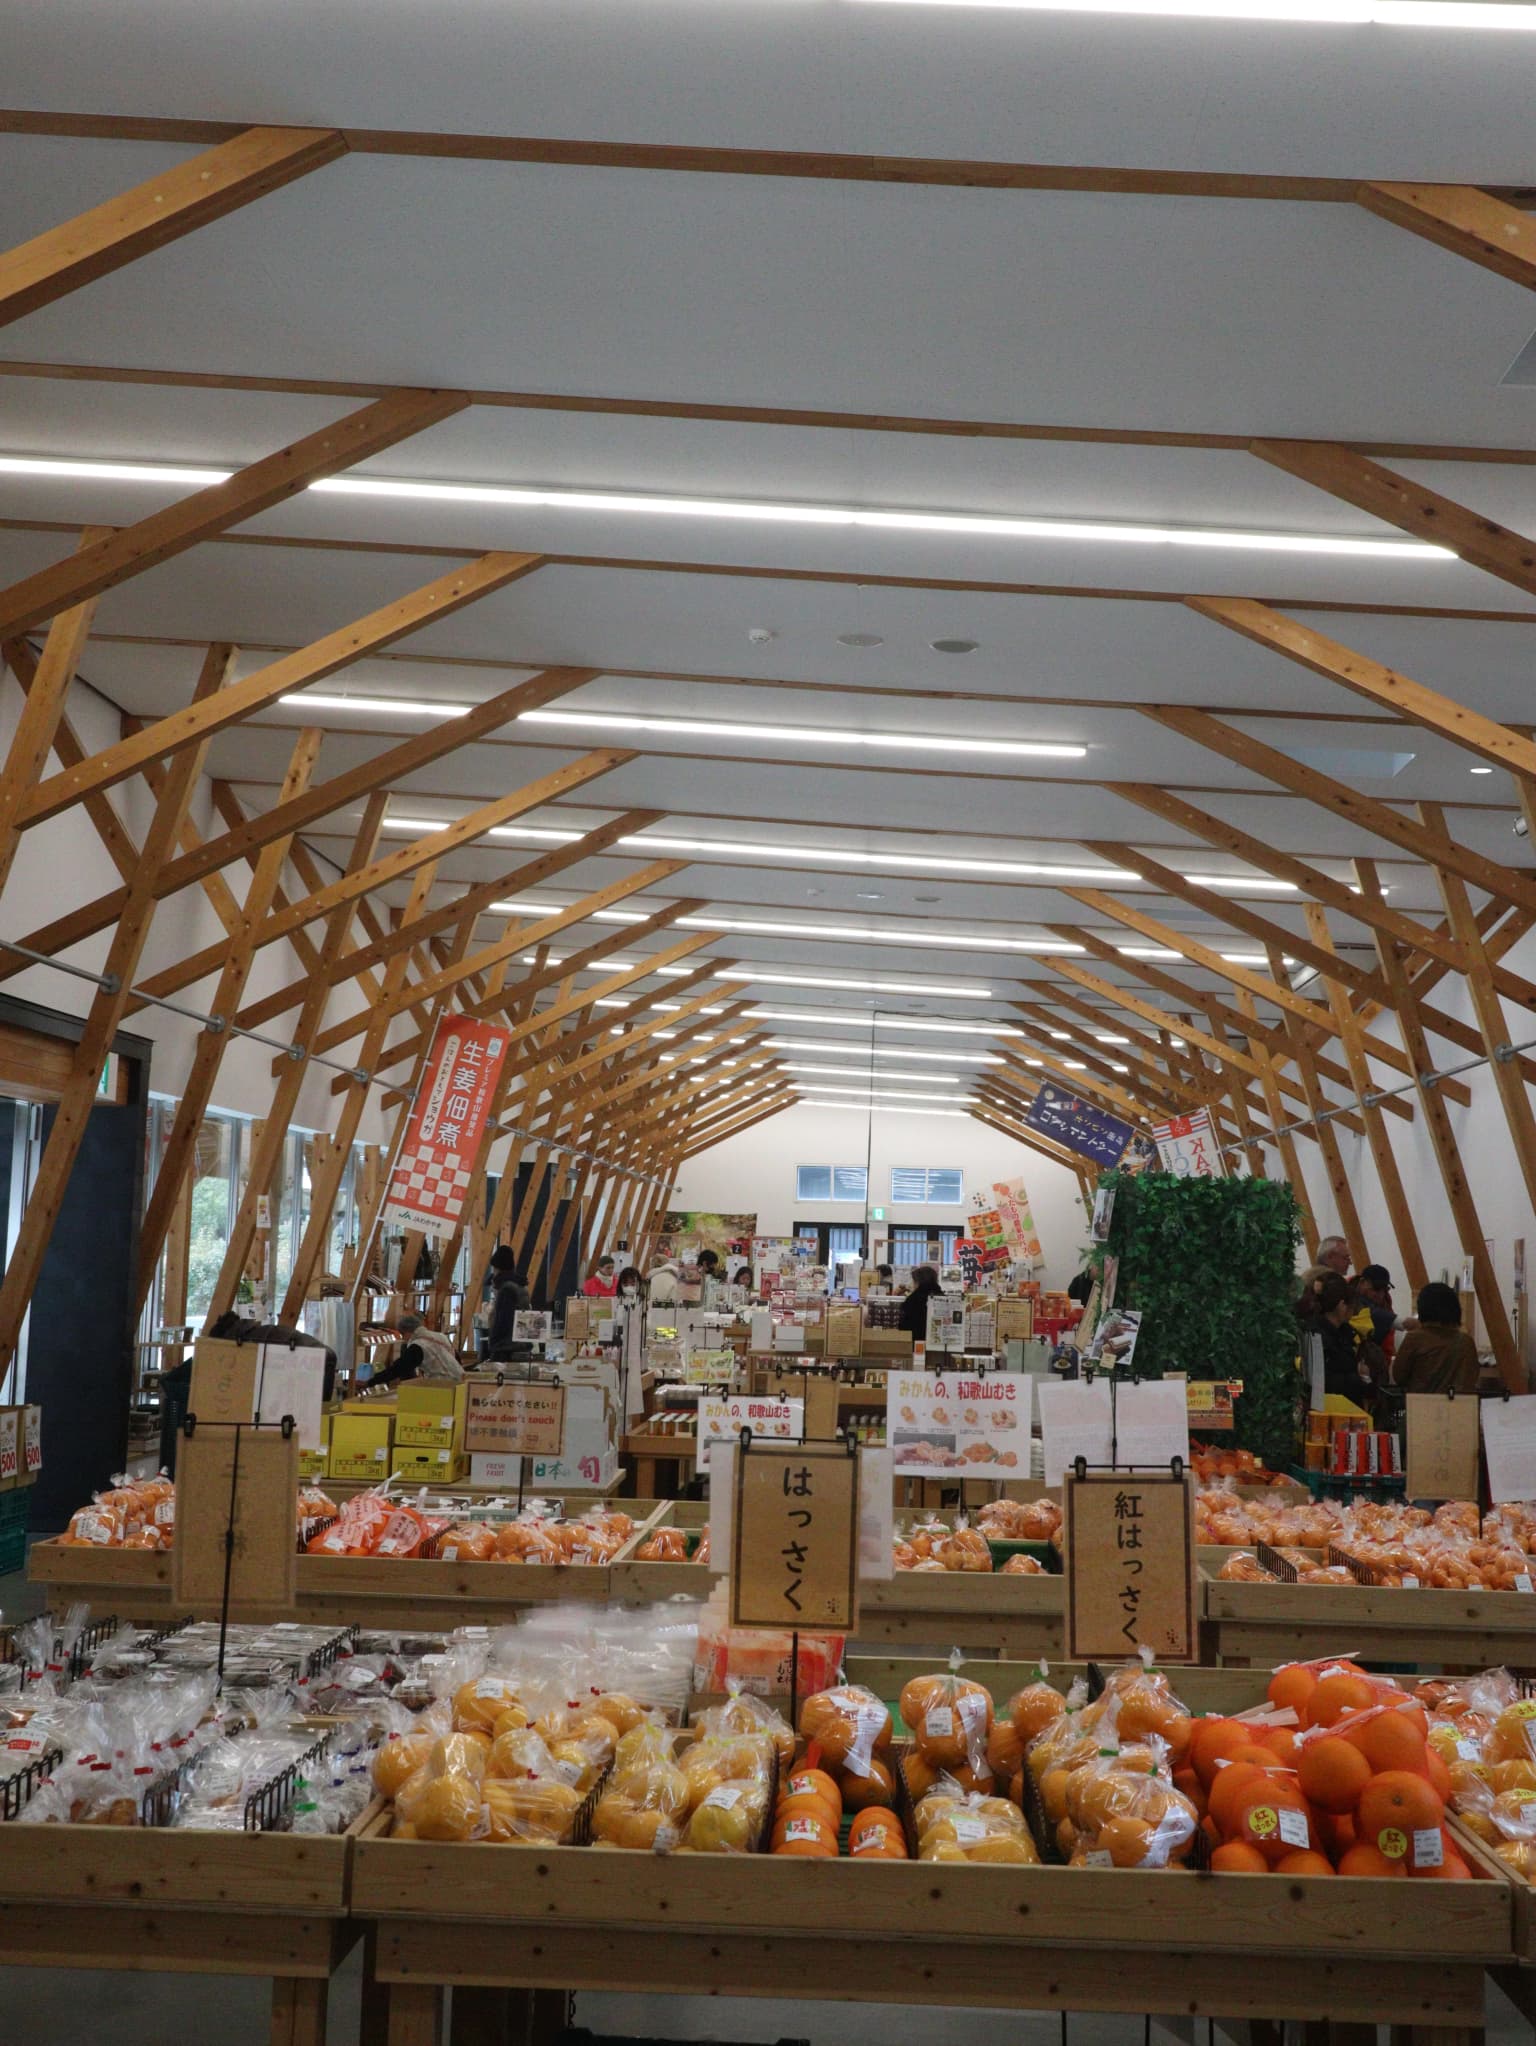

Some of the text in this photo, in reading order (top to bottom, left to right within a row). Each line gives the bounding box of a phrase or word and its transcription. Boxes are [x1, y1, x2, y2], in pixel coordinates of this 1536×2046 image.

[436, 1040, 484, 1148] 生姜佃煮
[528, 1415, 555, 1425] touch
[899, 1380, 1017, 1401] みかんの、和歌山むき
[782, 1467, 813, 1612] はっさく
[1113, 1491, 1144, 1644] 紅はっさく
